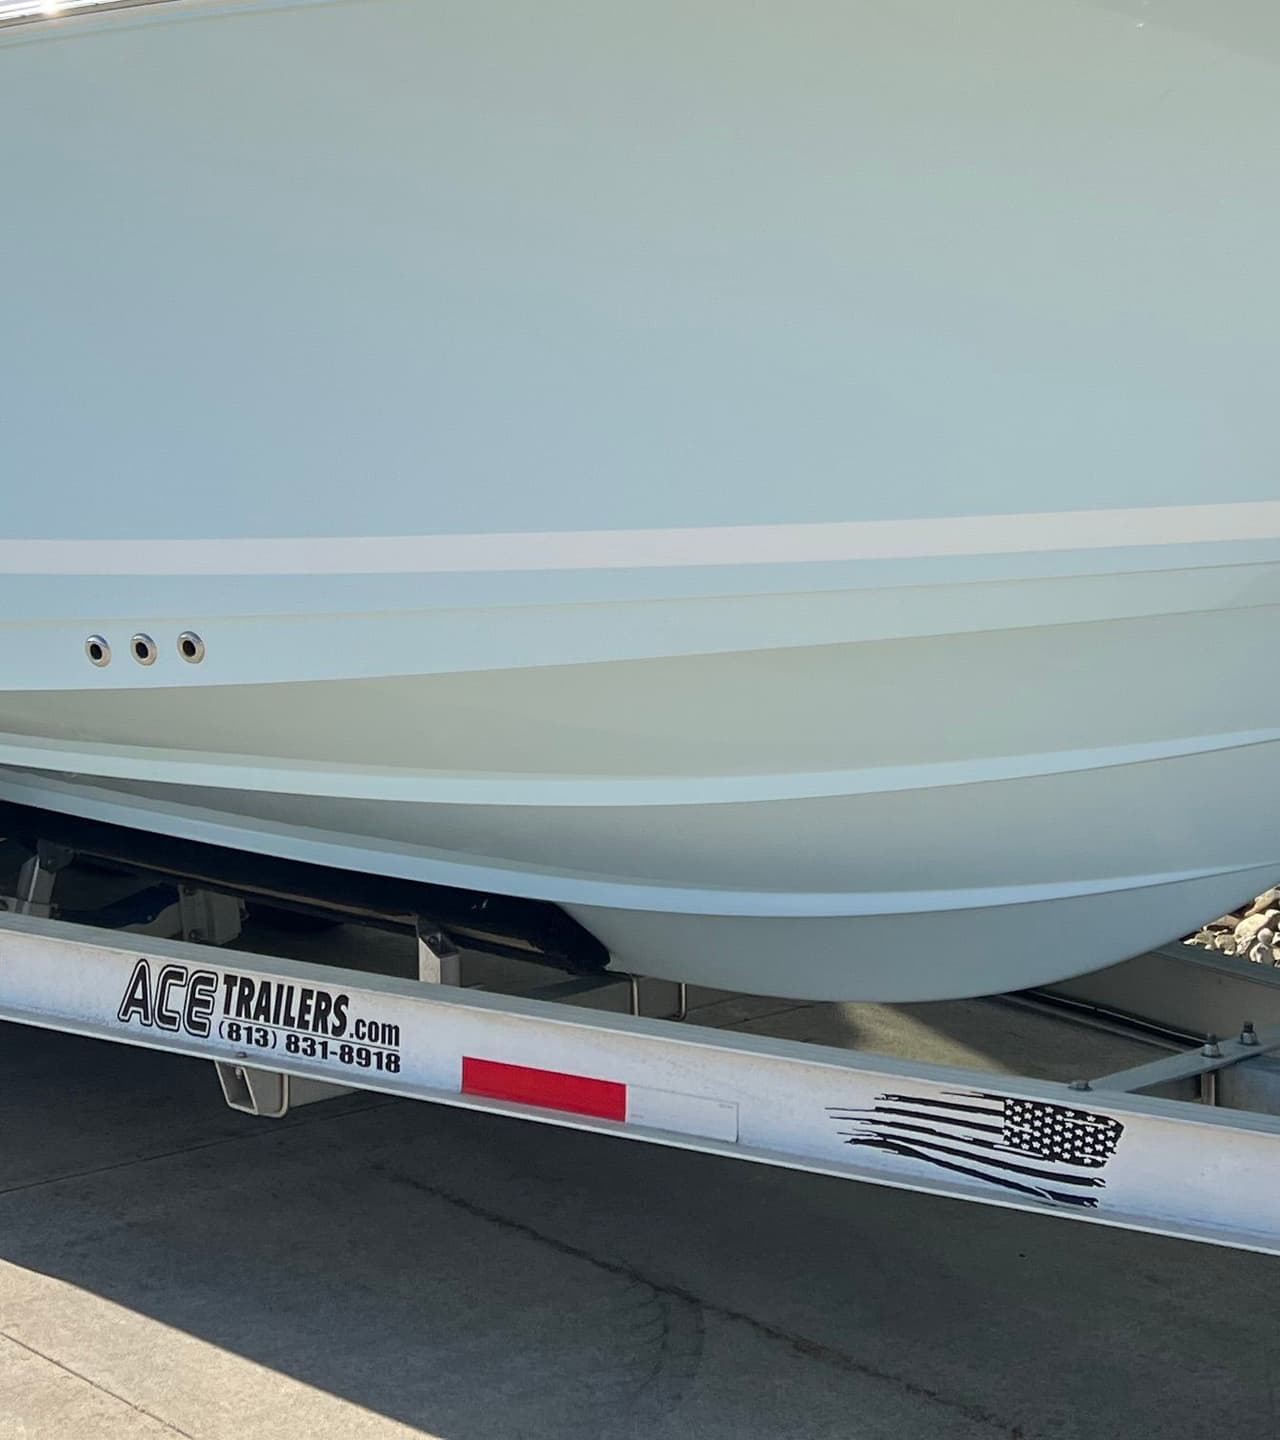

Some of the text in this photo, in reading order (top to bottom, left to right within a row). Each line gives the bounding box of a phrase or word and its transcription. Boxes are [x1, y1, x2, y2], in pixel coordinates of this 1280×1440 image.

[118, 959, 218, 1037] ACE
[219, 1020, 401, 1073] (813) 831-8918
